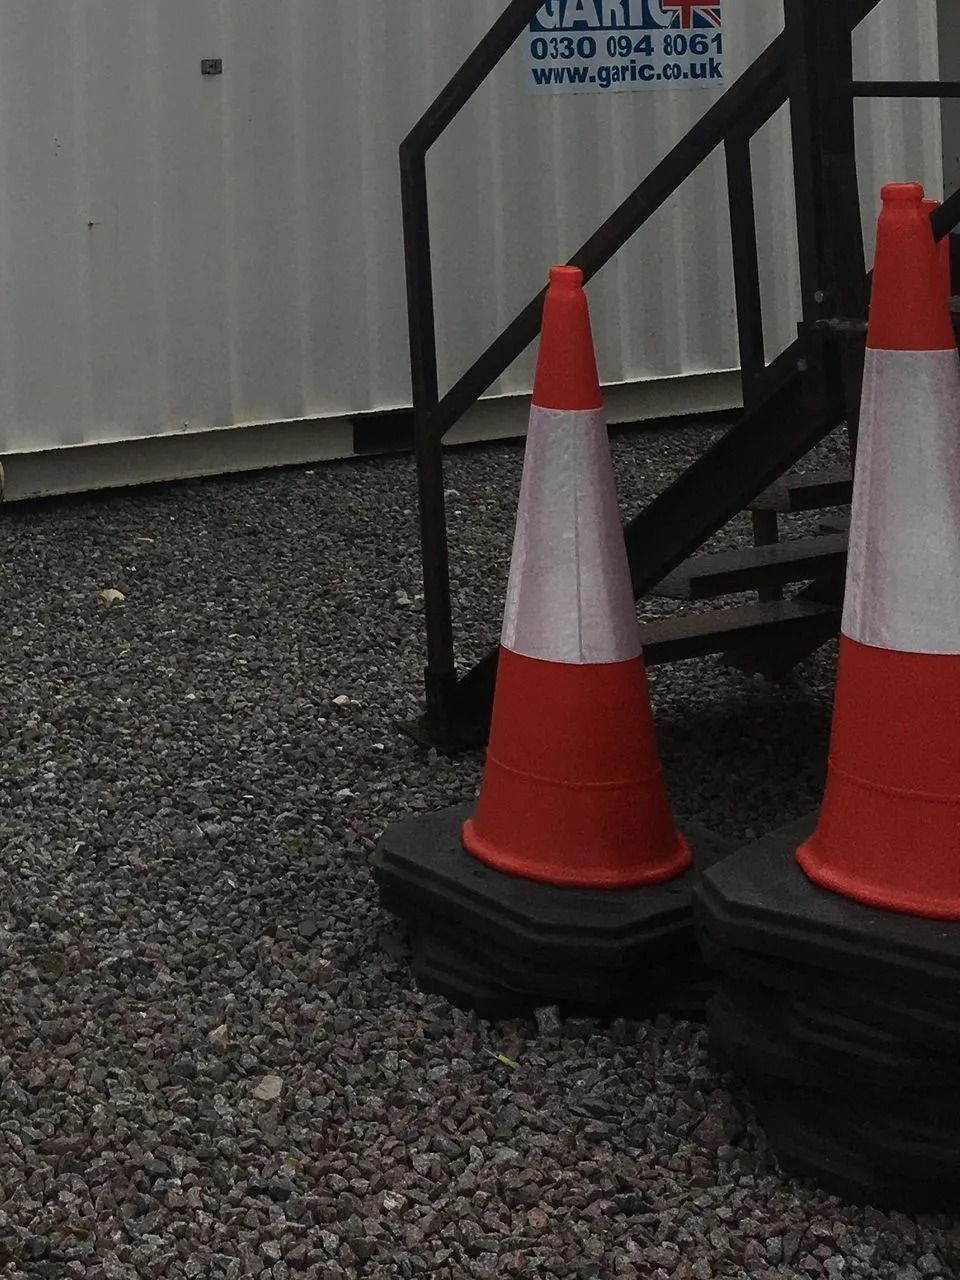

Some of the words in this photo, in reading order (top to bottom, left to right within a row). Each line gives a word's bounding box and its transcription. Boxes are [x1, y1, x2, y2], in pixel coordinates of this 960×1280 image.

[530, 36, 597, 60] 0330
[606, 34, 654, 58] 094
[663, 33, 723, 56] 8061
[531, 58, 723, 88] www.garic.co.uk
